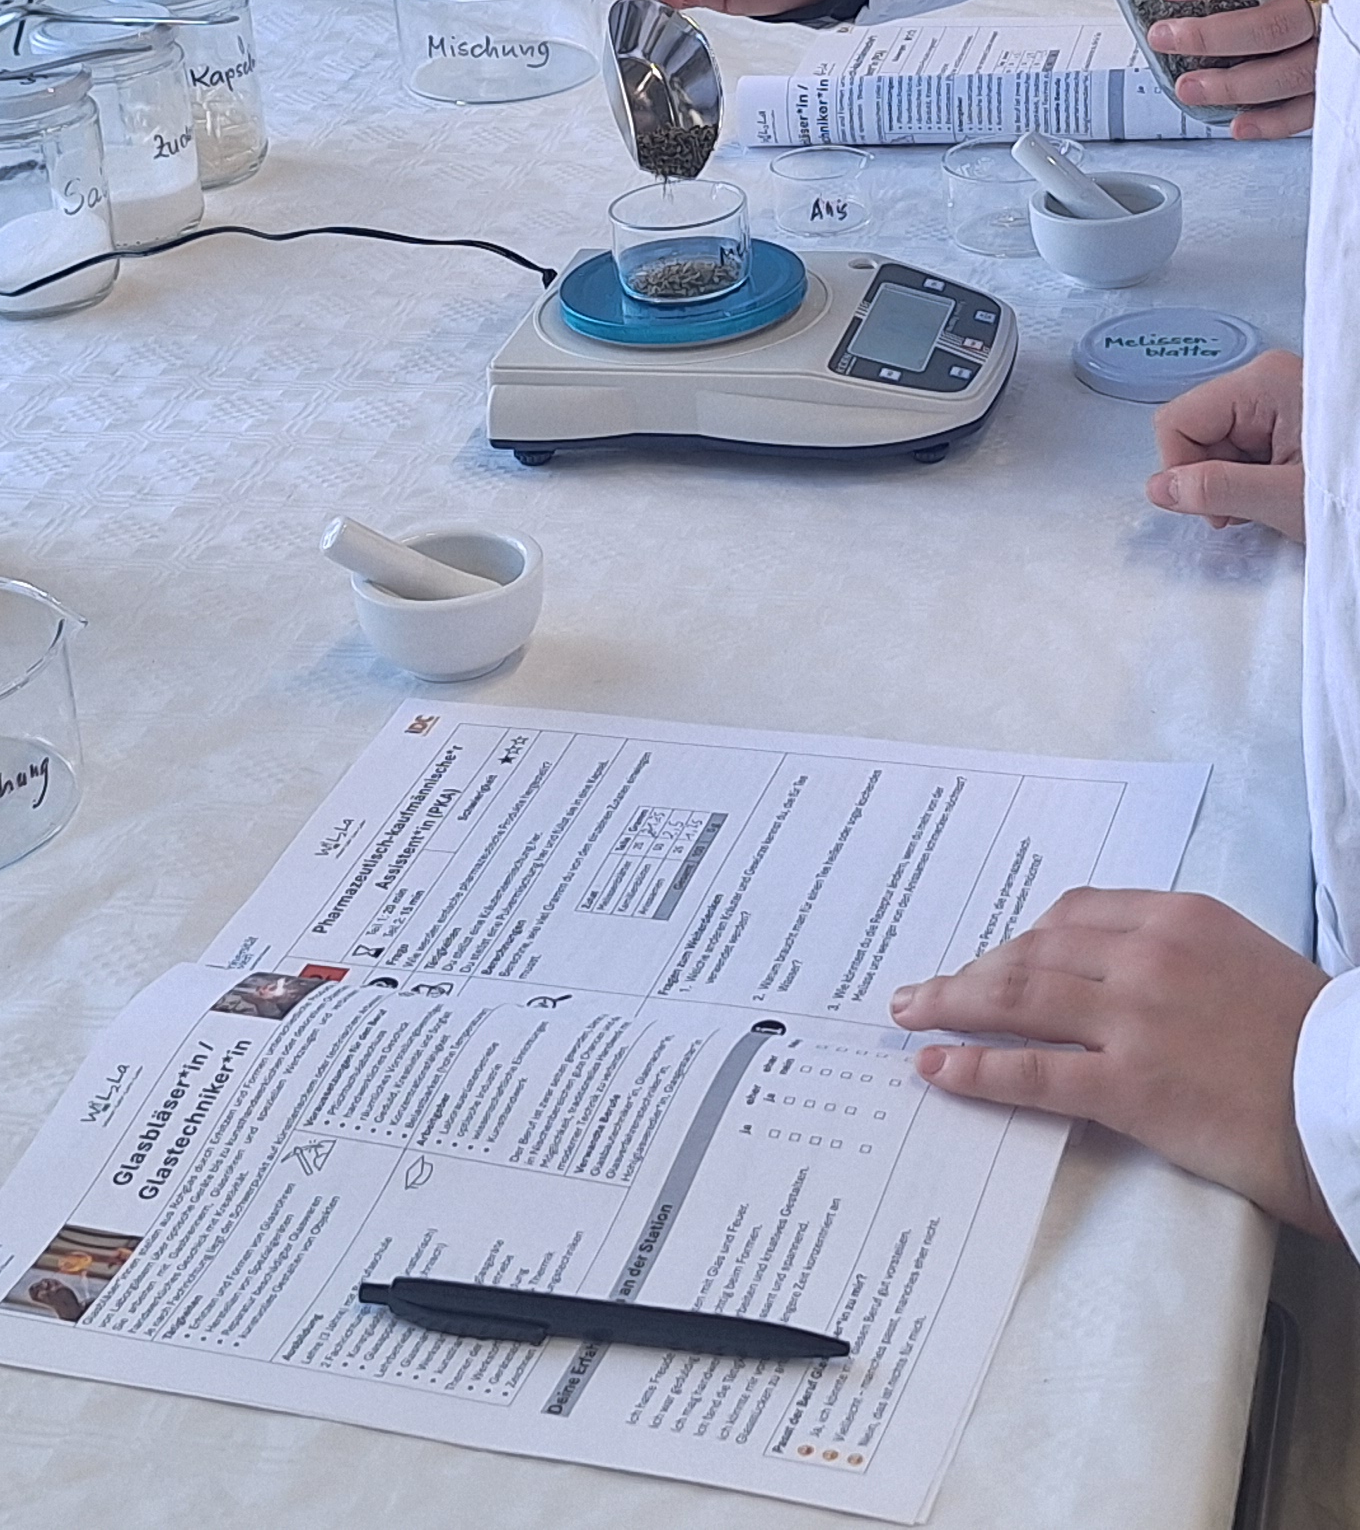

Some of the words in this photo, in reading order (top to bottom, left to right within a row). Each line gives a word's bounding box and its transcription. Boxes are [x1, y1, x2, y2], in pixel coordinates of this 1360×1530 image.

[427, 33, 550, 70] Mischung
[810, 194, 848, 222] Anis
[424, 787, 463, 818] (PKA)
[195, 1040, 217, 1052] /
[636, 1203, 676, 1253] Station
[623, 1253, 649, 1277] der
[615, 1278, 636, 1296] an
[545, 1375, 582, 1415] Deine
